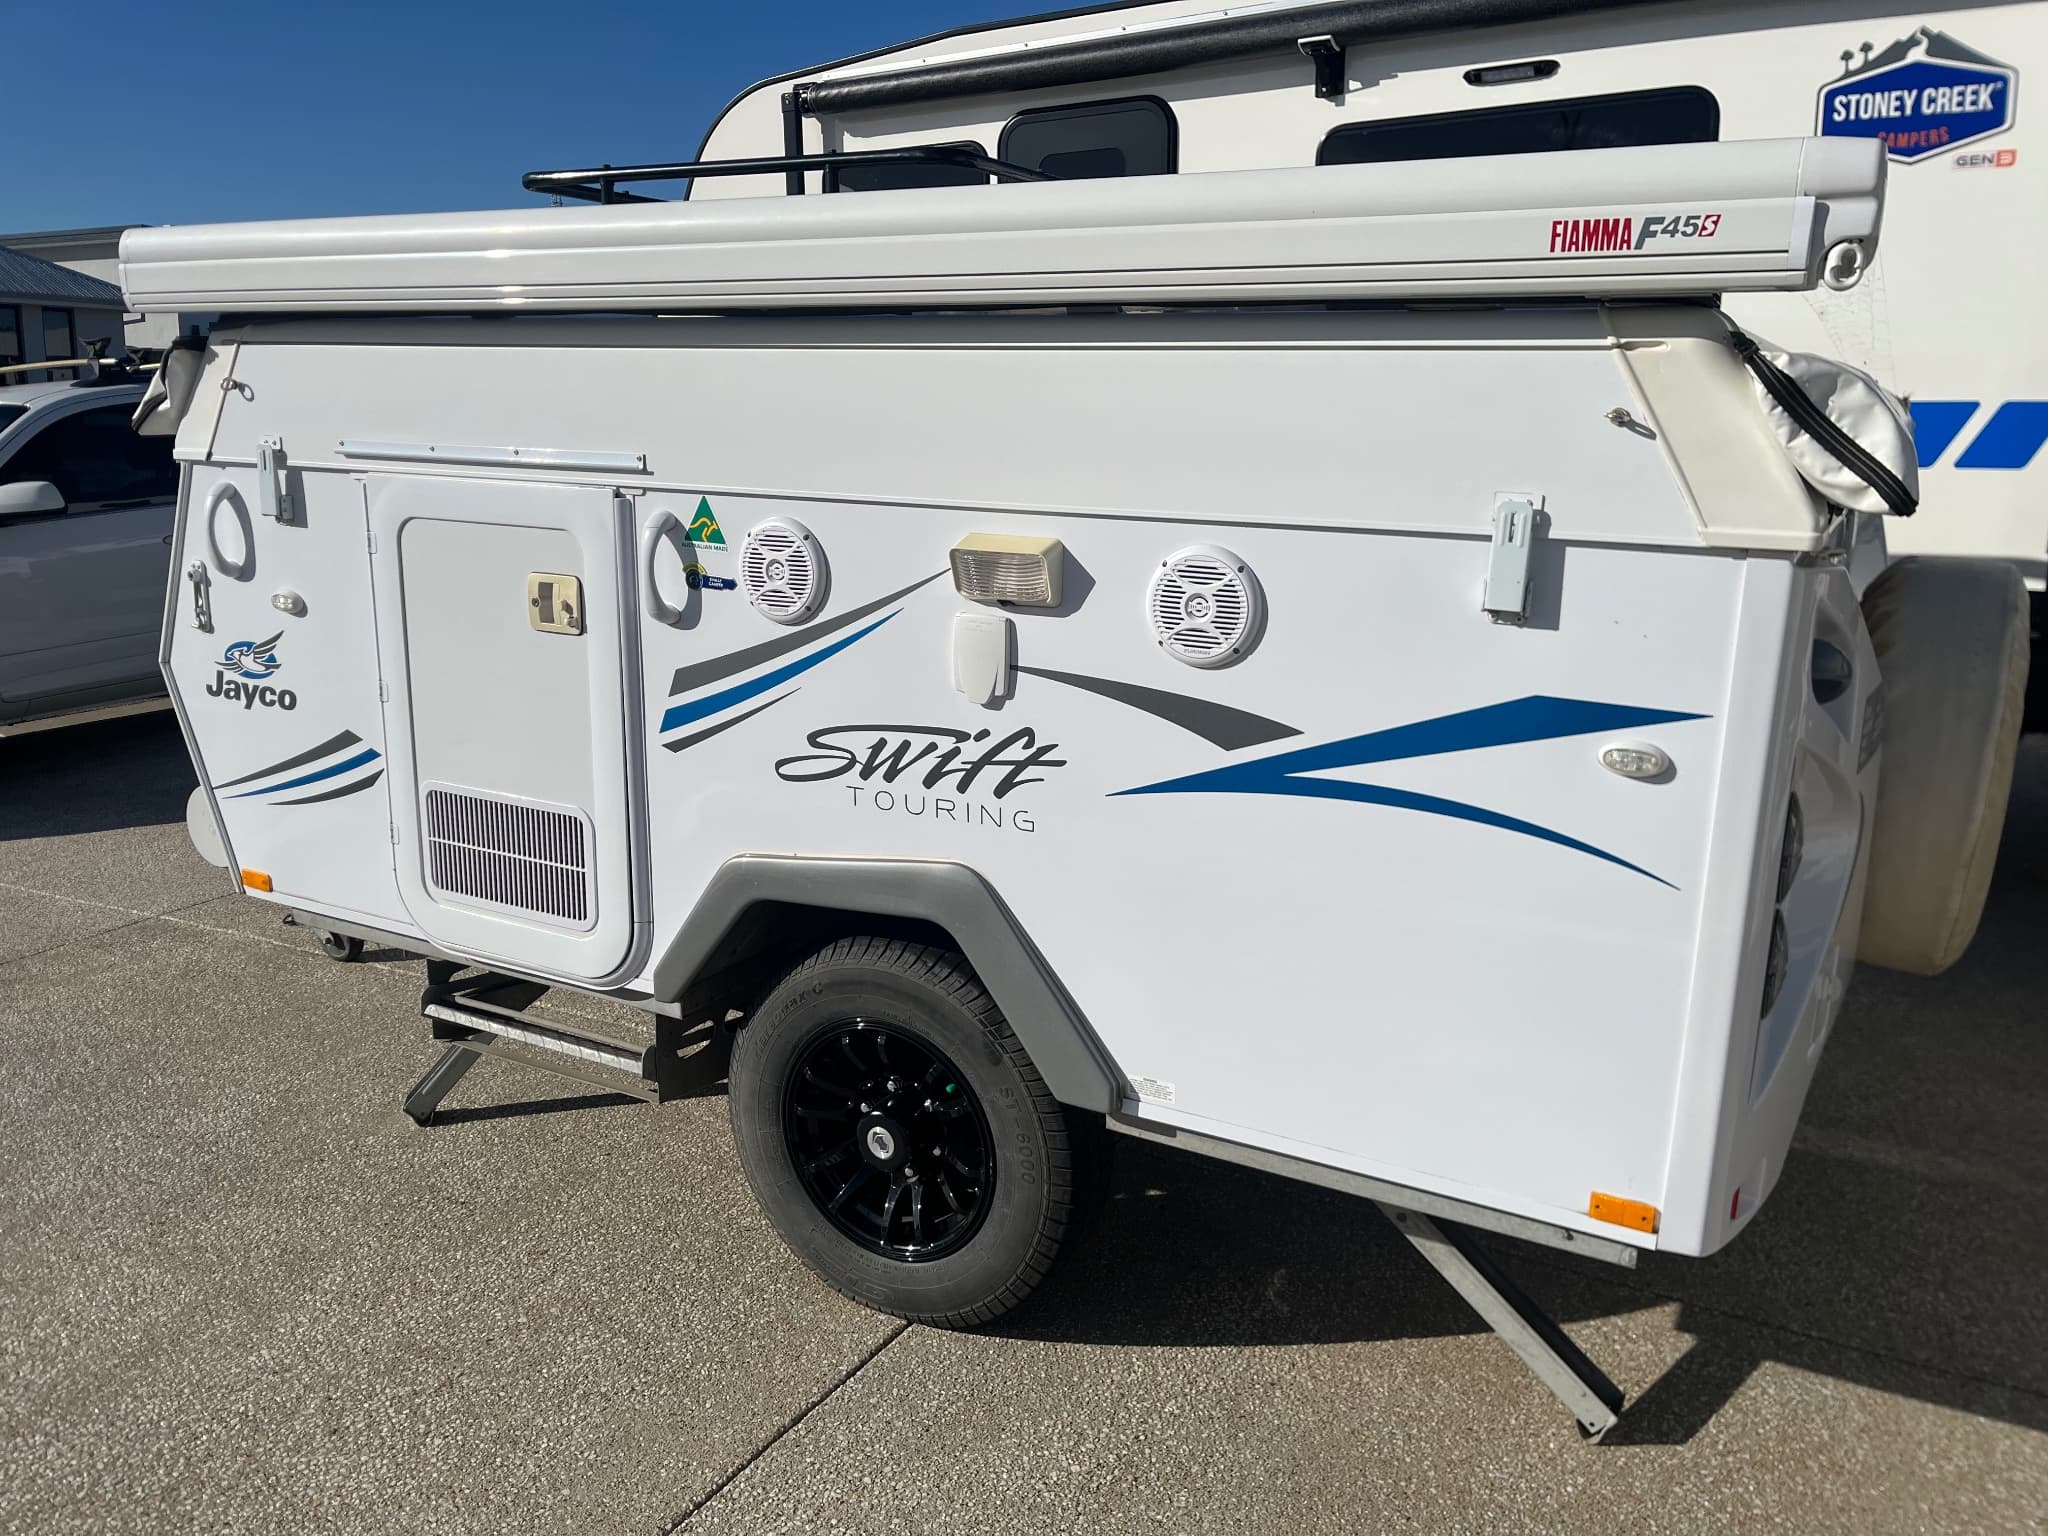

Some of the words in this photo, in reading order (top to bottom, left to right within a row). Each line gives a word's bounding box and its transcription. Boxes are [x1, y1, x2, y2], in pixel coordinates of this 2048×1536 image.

[1832, 88, 1919, 122] STONEY
[1920, 82, 1994, 116] CREEK
[1550, 217, 1633, 253] FIAMMA
[205, 670, 298, 711] Jayco
[774, 724, 1068, 800] Swift
[845, 785, 1036, 832] TOURING
